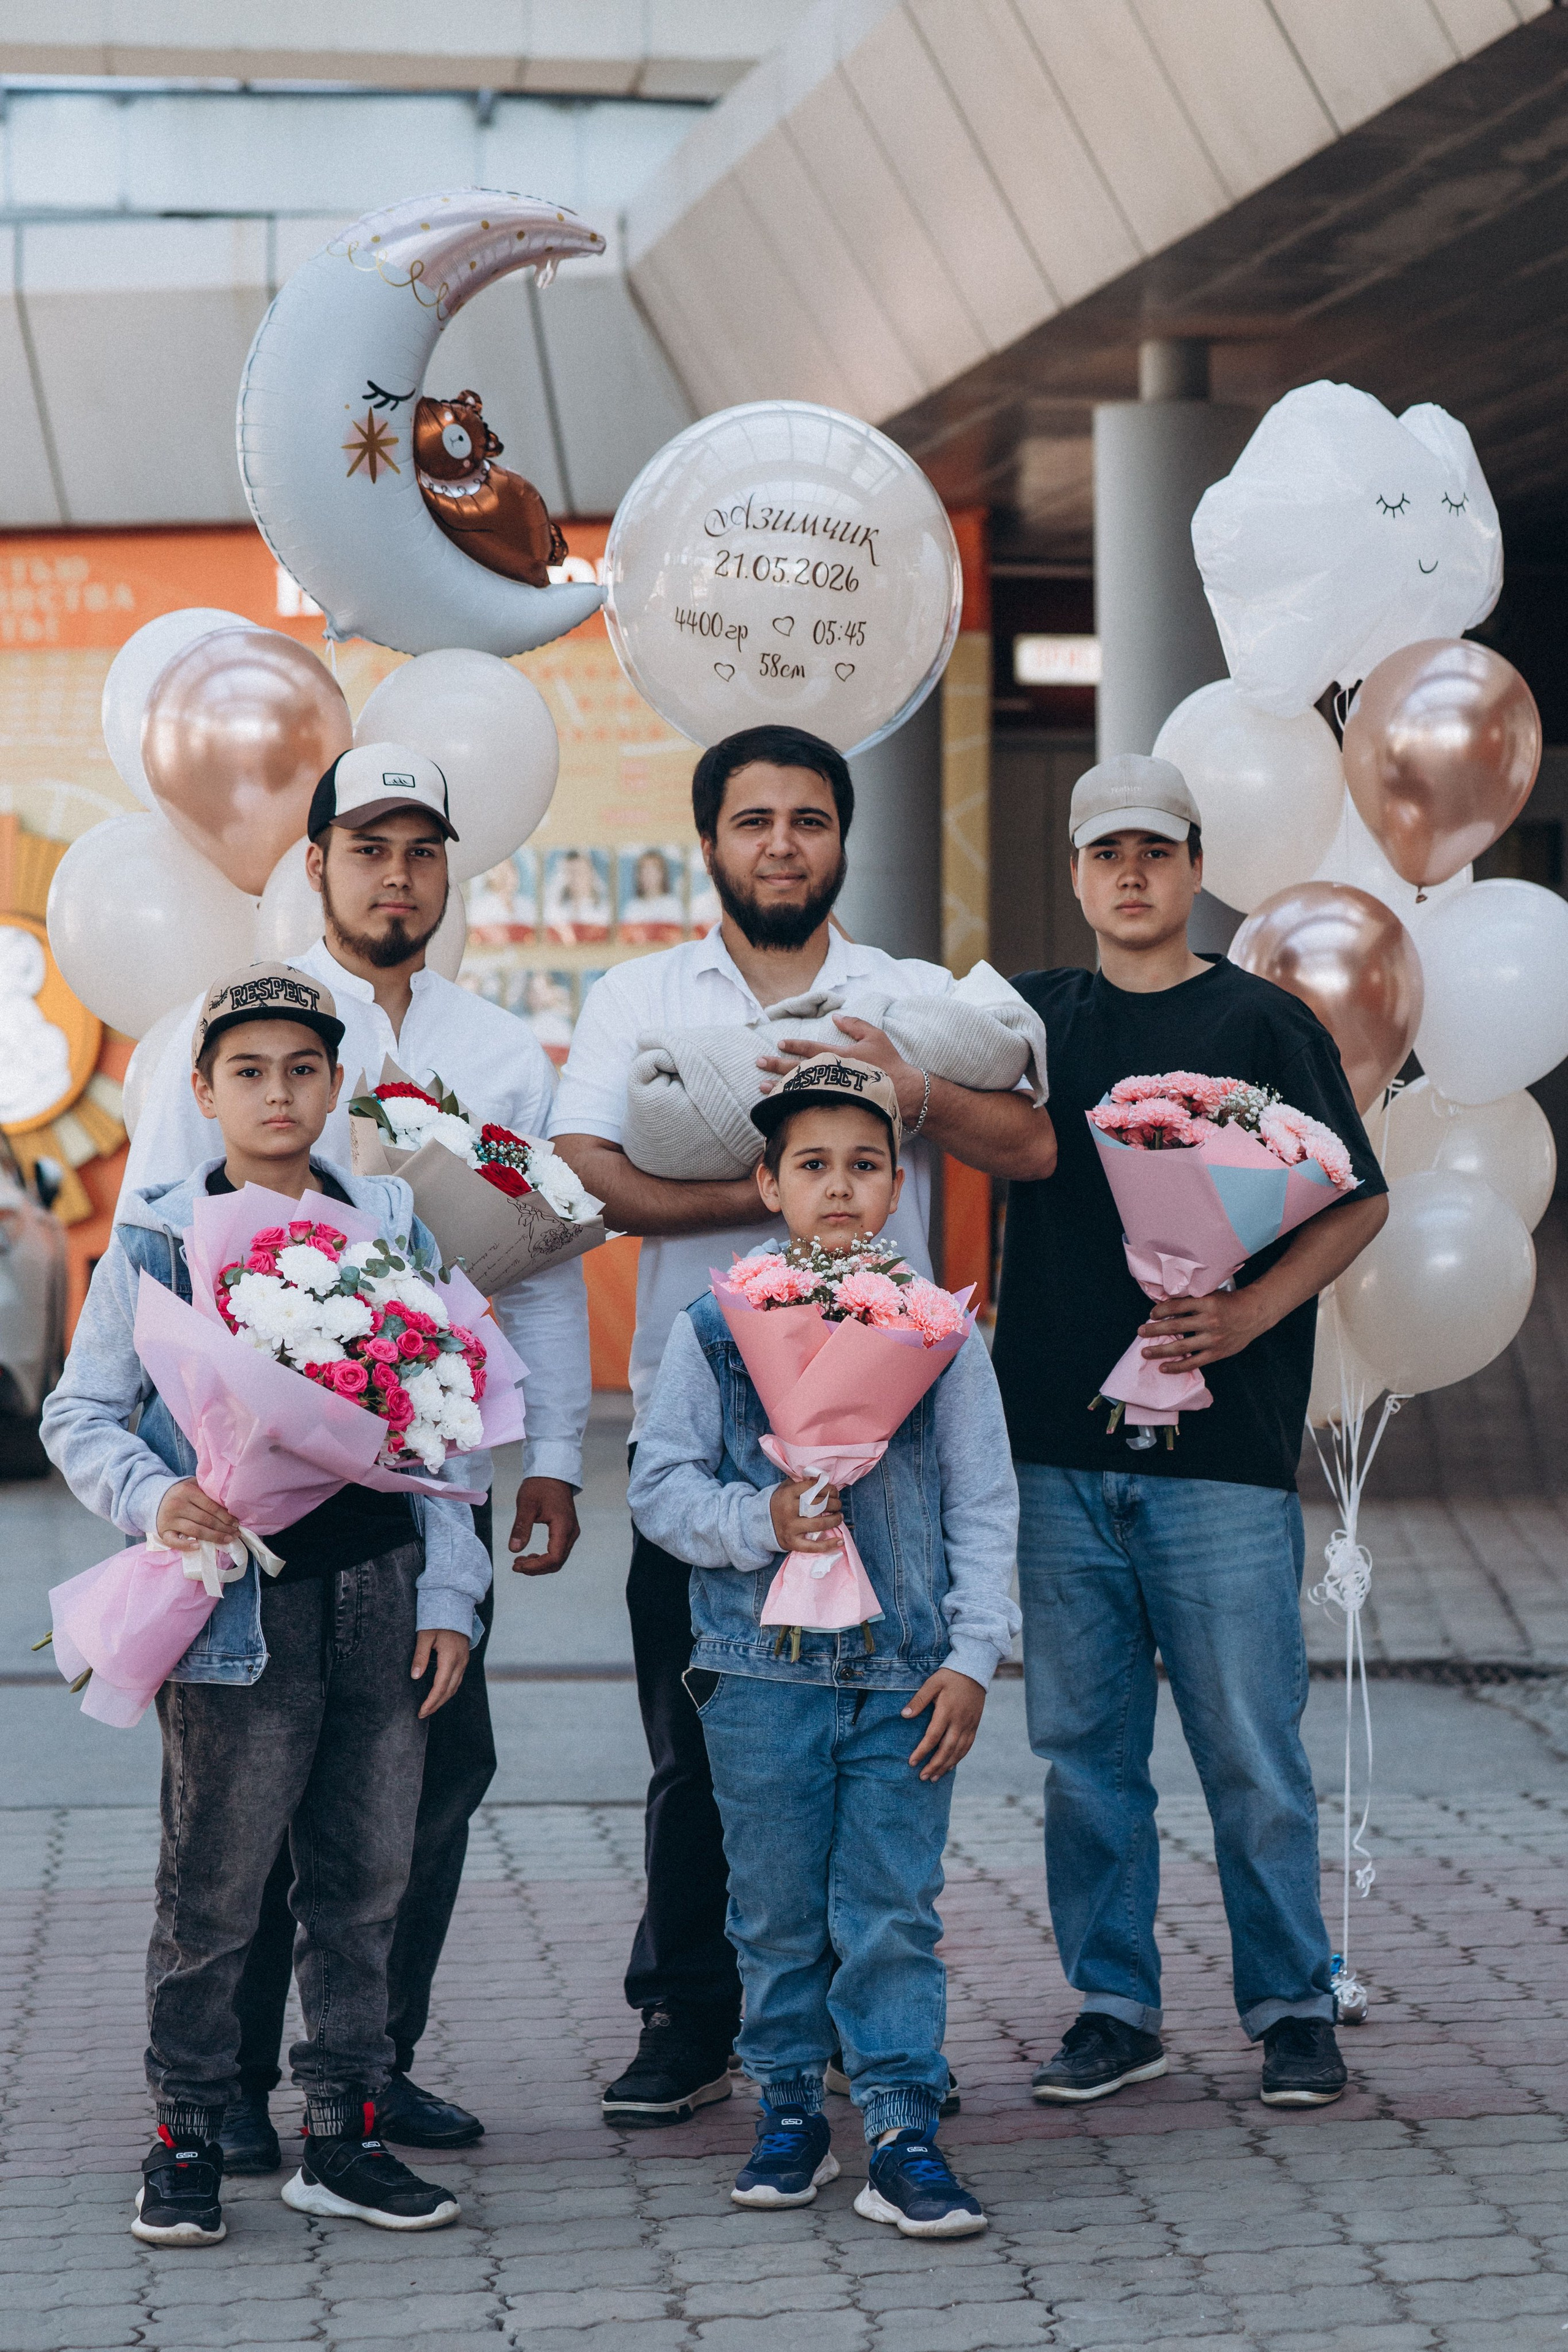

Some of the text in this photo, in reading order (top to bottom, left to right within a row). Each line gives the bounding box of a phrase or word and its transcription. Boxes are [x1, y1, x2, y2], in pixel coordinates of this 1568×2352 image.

[714, 549, 859, 592] 21.05.2026
[812, 619, 867, 647] 05:45
[230, 976, 320, 1011] RESPECT
